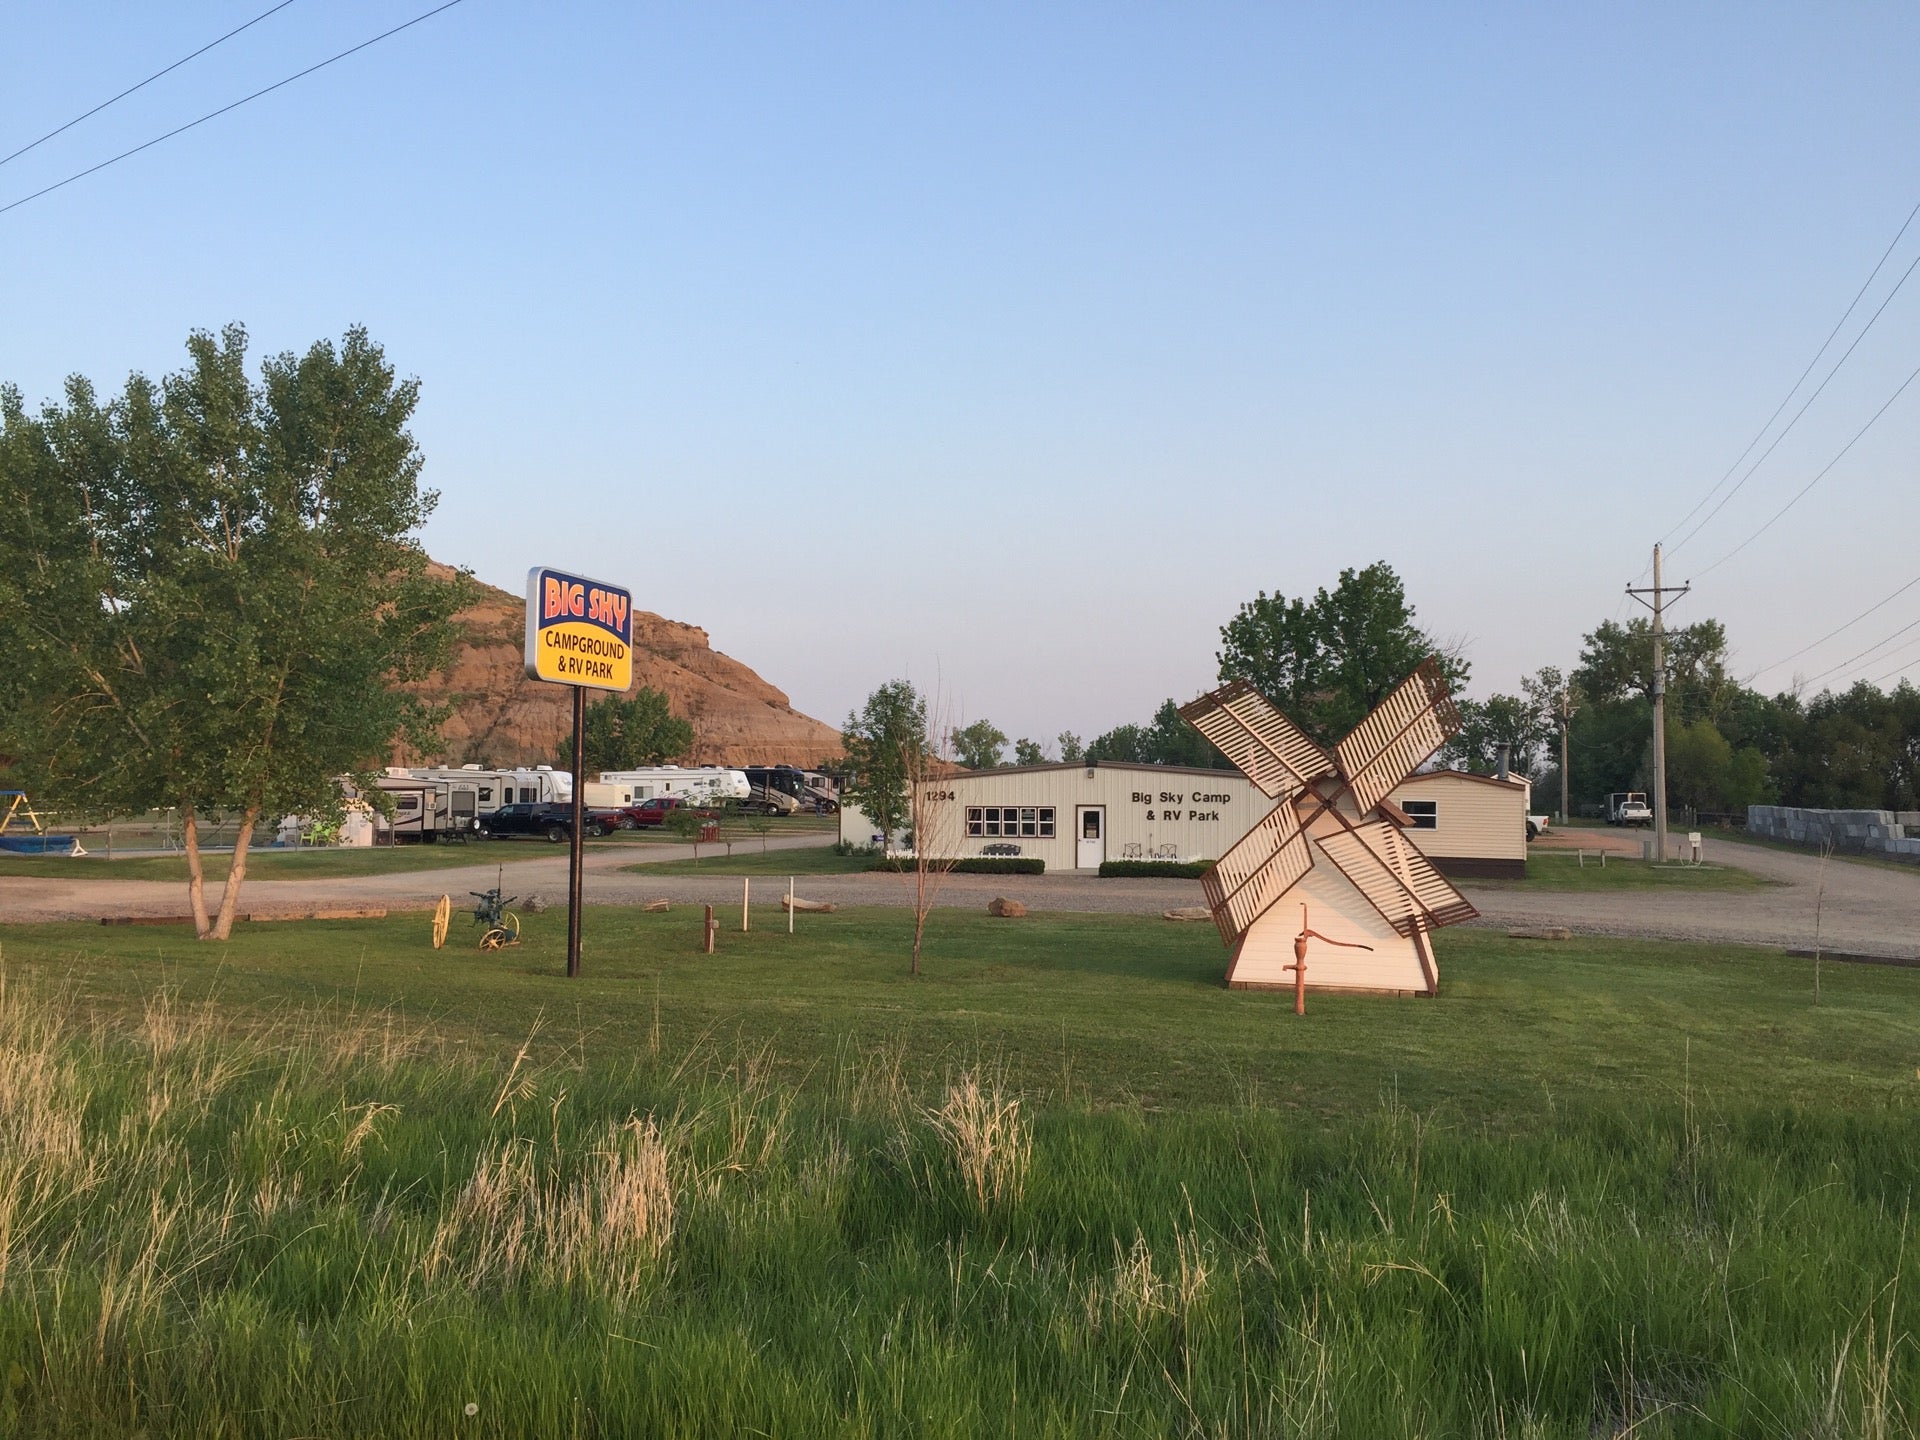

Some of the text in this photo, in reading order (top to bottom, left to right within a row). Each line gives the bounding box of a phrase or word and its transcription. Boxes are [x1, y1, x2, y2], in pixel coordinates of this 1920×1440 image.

[545, 577, 627, 633] BIG SKY
[545, 630, 624, 659] CAMPGROUND
[558, 655, 613, 679] & RV PARK
[926, 791, 955, 801] 1294
[1131, 792, 1231, 804] Big Sky Camp
[1146, 810, 1219, 821] & RV Park
